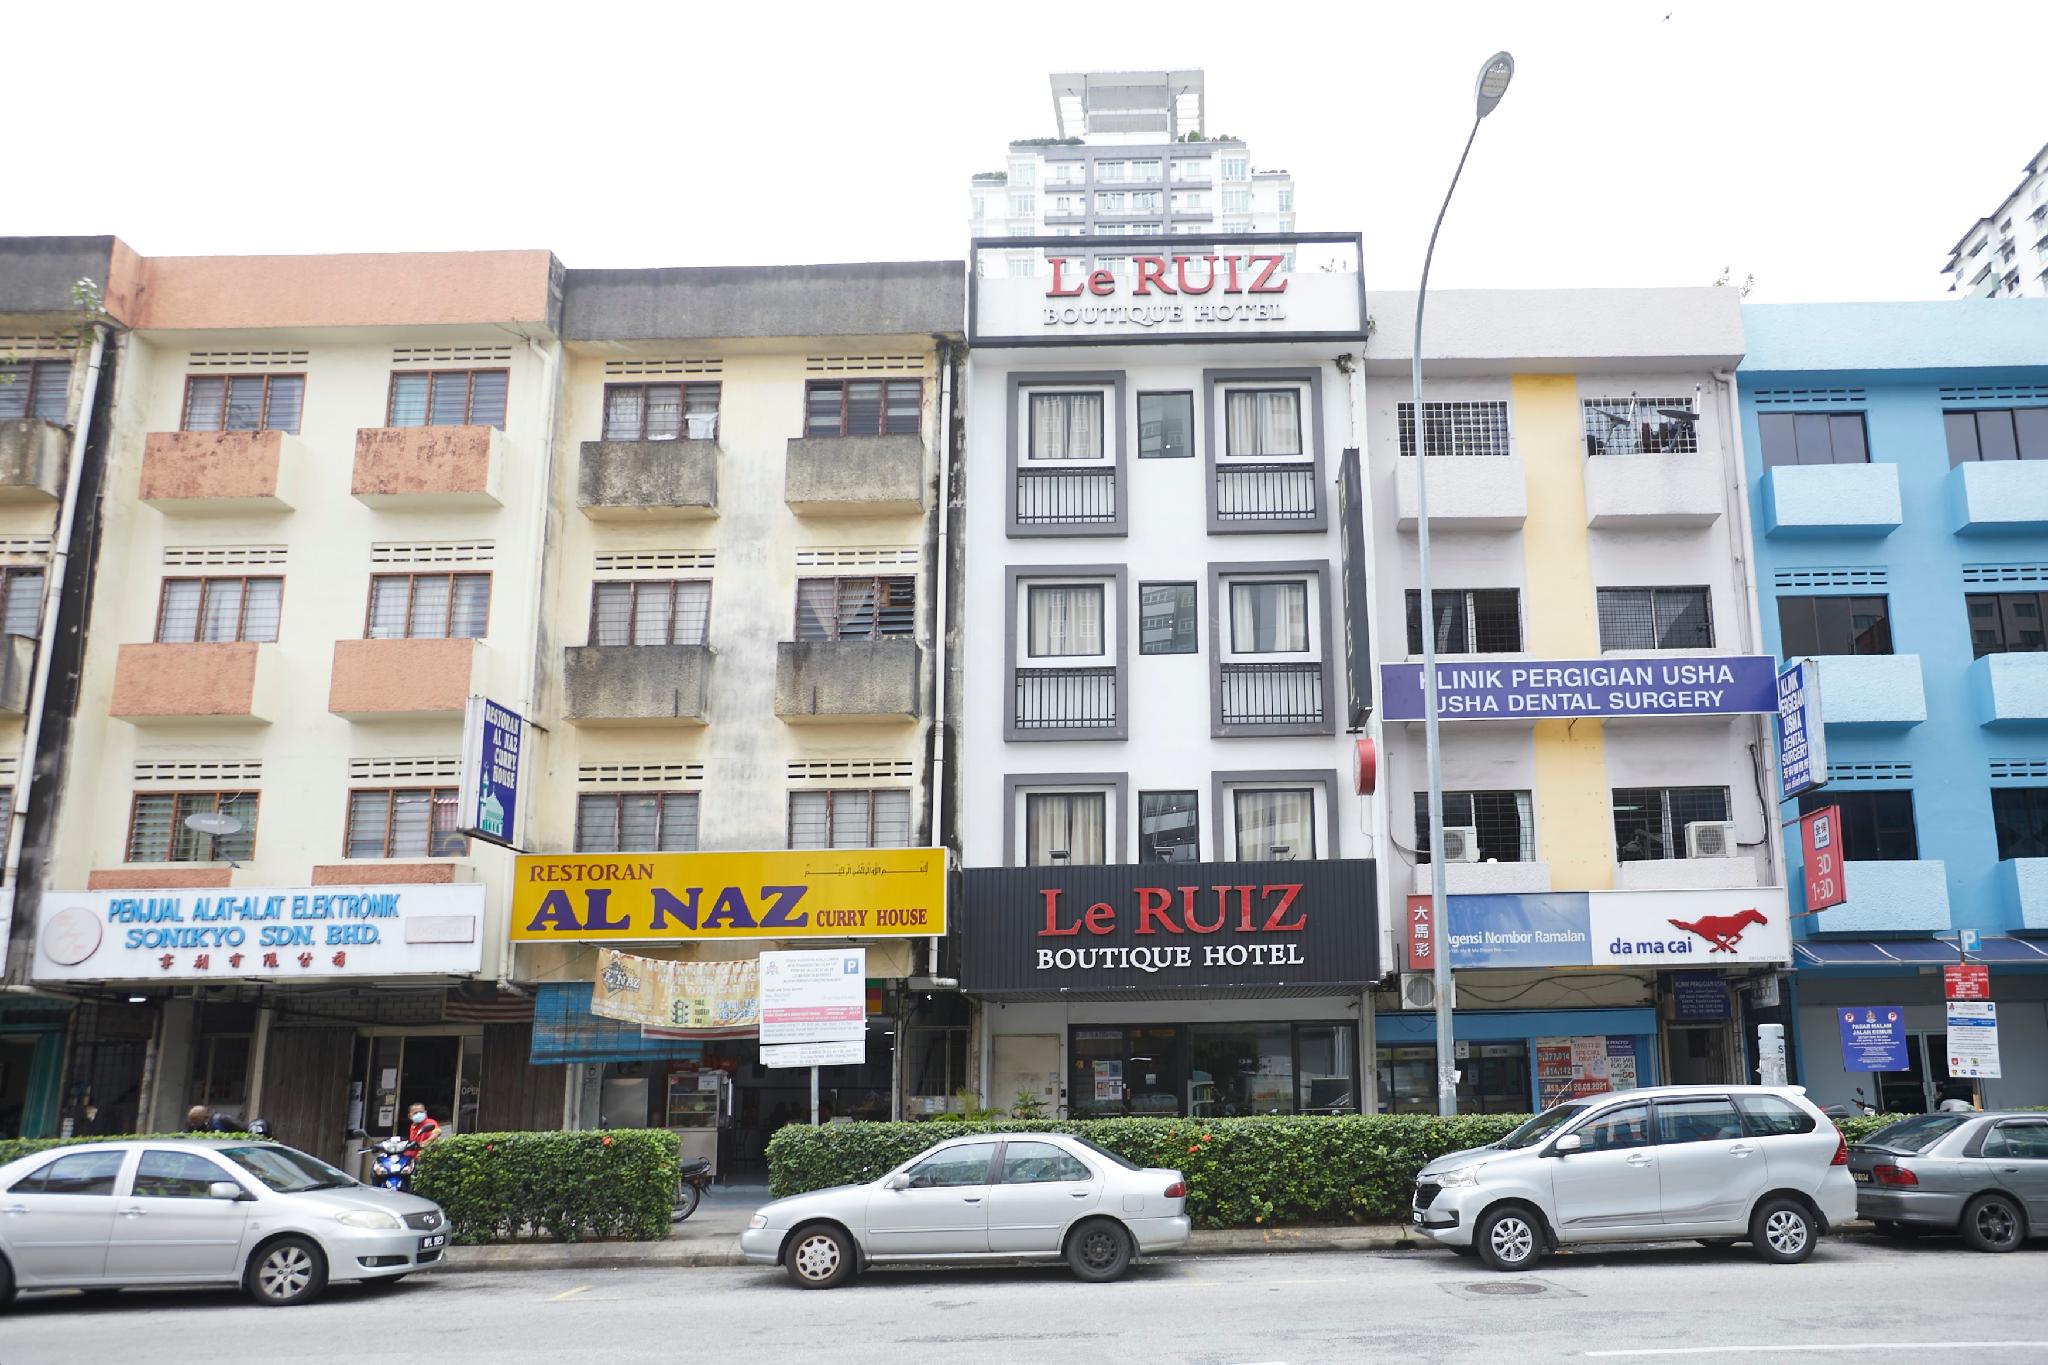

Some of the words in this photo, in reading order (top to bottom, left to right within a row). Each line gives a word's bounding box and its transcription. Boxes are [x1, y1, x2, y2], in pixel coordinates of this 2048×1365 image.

[1046, 256, 1116, 298] Le
[1133, 254, 1289, 296] RUIZ
[1044, 306, 1184, 327] BOUTIQUE
[1194, 304, 1287, 323] HOTEL
[1512, 666, 1654, 688] PERGIGIAN
[1663, 664, 1735, 685] USHA
[1508, 692, 1600, 712] DENTAL
[1609, 689, 1724, 710] SURGERY
[486, 703, 520, 735] RESTORAN
[1784, 711, 1802, 736] USHA
[493, 727, 502, 747] AL
[503, 731, 518, 753] NAZ
[1783, 730, 1806, 752] DENTAL
[494, 746, 517, 772] CURRY
[1781, 742, 1808, 767] SURGERY
[492, 764, 516, 789] HOUSE
[529, 863, 655, 882] RESTORAN
[1816, 853, 1832, 876] 3D
[108, 898, 185, 924] PENJUAL
[192, 895, 286, 922] ALAT-ALAT
[290, 893, 401, 920] ELEKTRONIK
[526, 888, 631, 932] AL
[649, 886, 809, 931] NAZ
[816, 910, 868, 927] CURRY
[876, 908, 928, 926] HOUSE
[1038, 888, 1117, 936] Le
[1133, 884, 1308, 934] RUIZ
[125, 926, 246, 949] SONIKYO
[259, 924, 316, 947] SDN.
[325, 923, 381, 946] BHD.
[1414, 905, 1431, 958] 大馬彩
[1485, 931, 1532, 944] Nombor
[1535, 930, 1586, 943] Ramalan
[847, 960, 857, 973] P
[1036, 946, 1192, 973] BOUTIQUE
[1203, 943, 1305, 966] HOTEL
